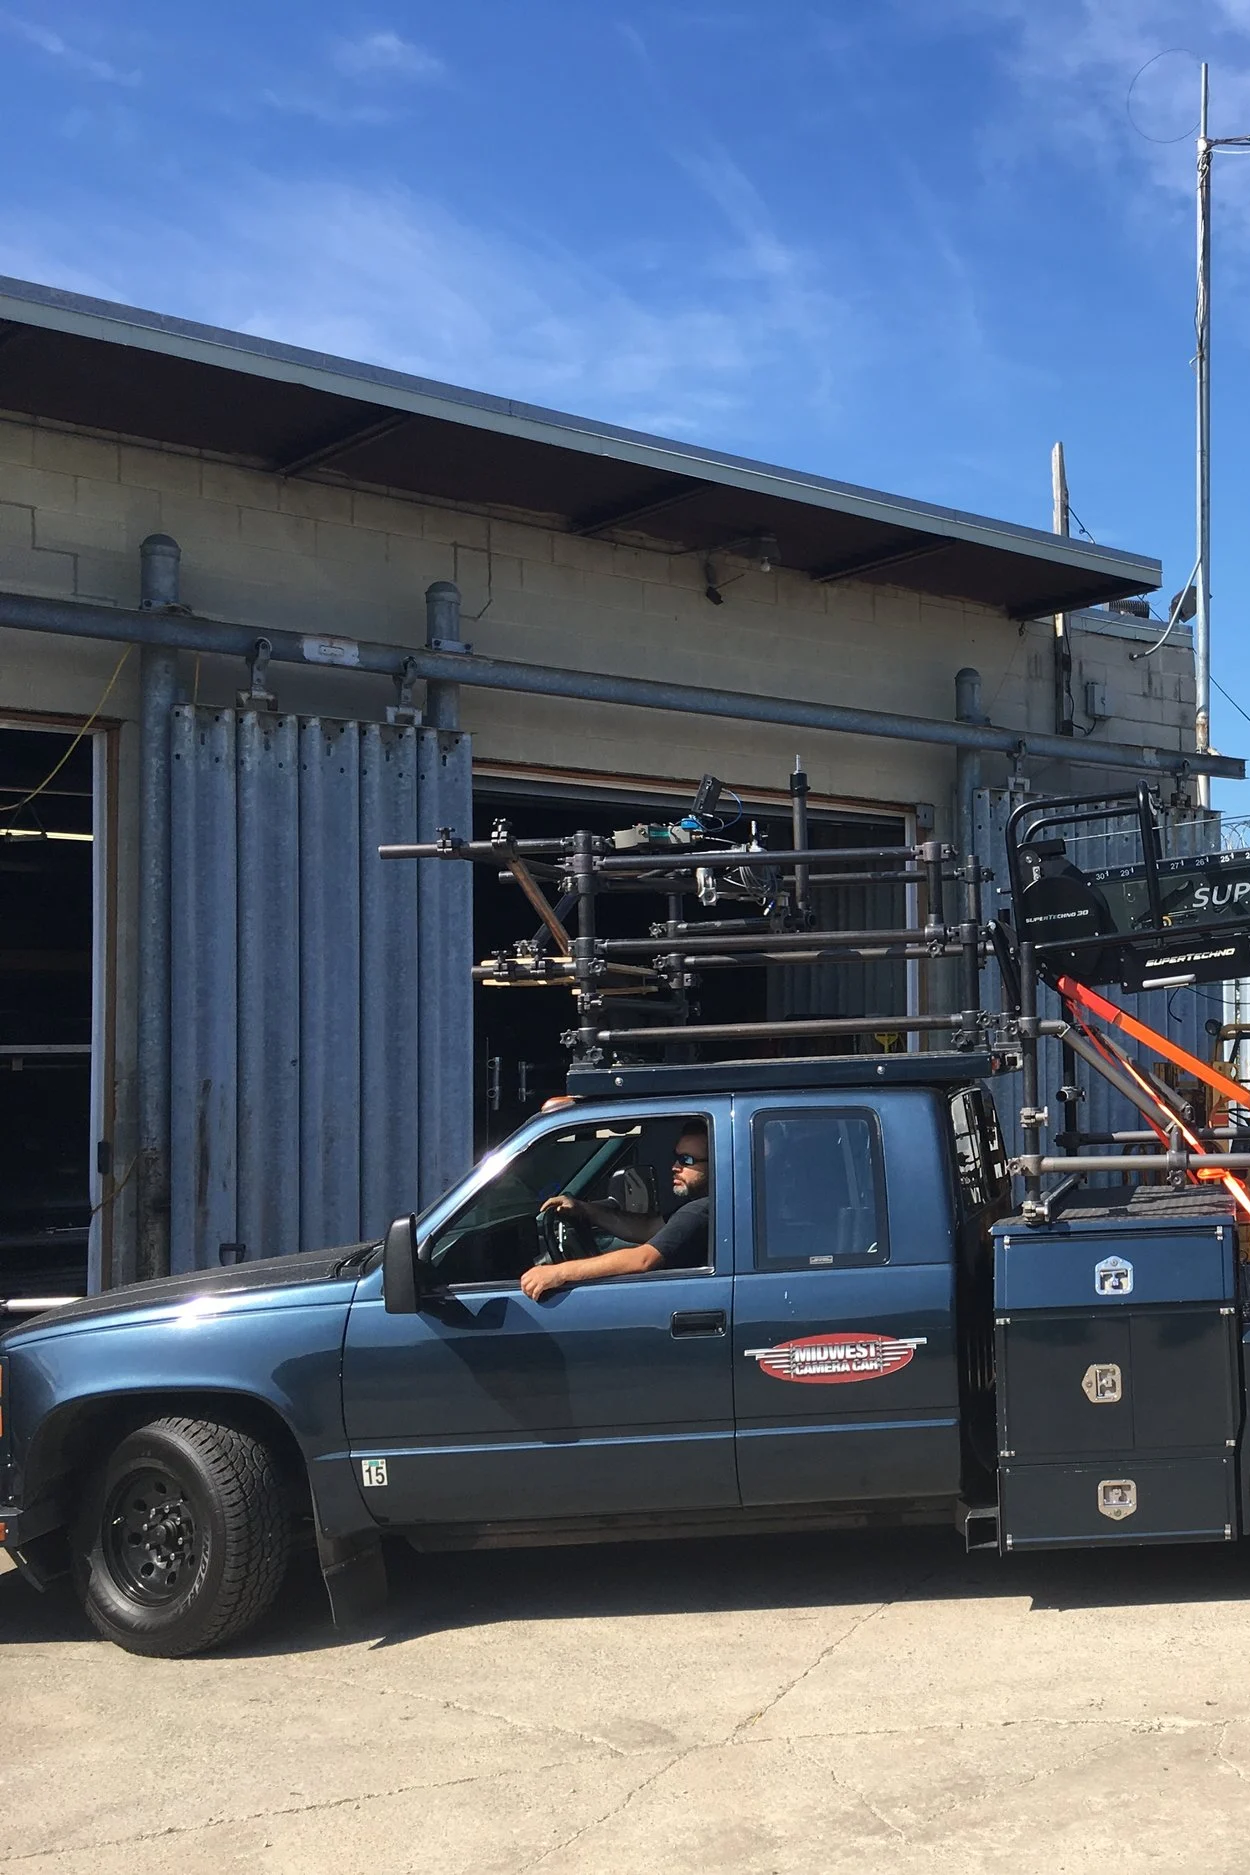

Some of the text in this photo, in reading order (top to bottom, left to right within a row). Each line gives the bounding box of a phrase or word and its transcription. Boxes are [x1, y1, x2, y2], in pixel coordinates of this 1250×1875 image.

[1145, 948, 1235, 967] SUPERTECHNO
[795, 1343, 878, 1361] MIDWEST
[795, 1357, 879, 1376] CAMERA CAR
[365, 1466, 385, 1485] 15
